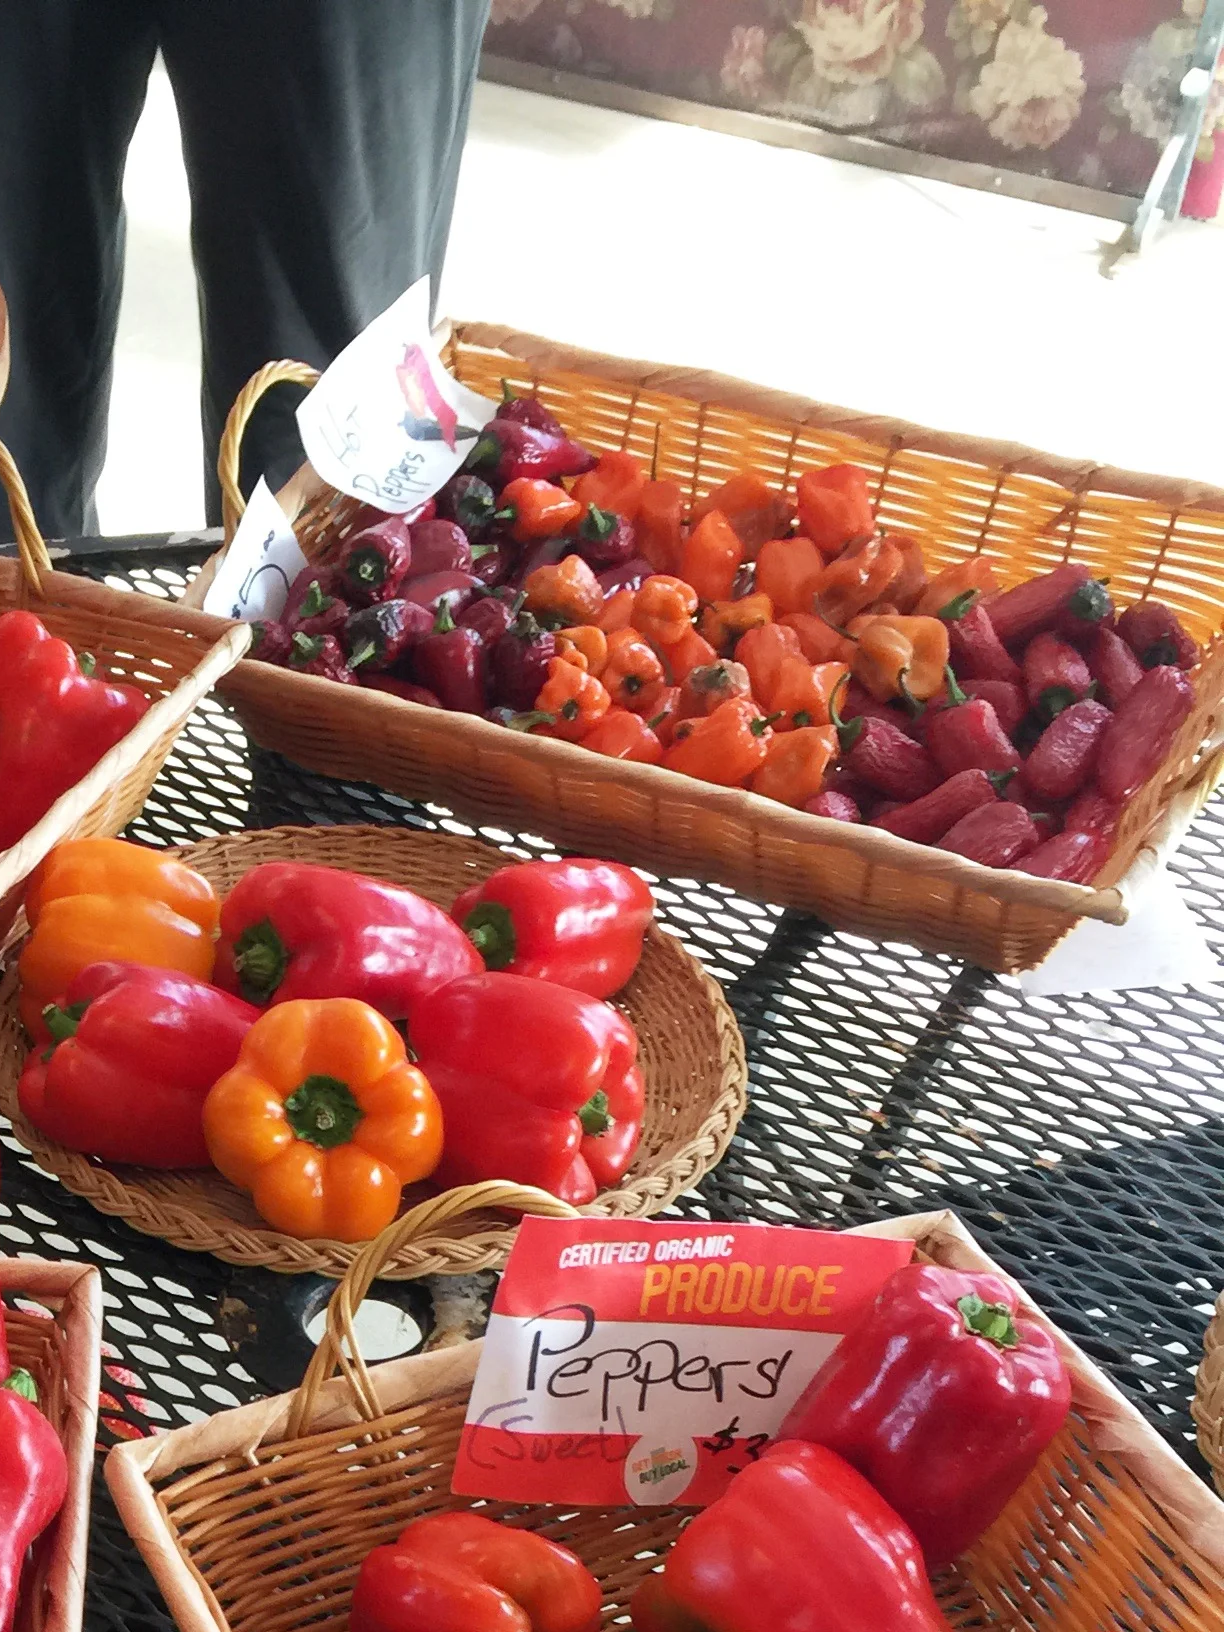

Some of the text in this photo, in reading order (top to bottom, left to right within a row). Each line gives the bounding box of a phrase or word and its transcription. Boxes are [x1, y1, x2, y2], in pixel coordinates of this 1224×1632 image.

[559, 1234, 735, 1269] CERTIFIED ORGANIC
[640, 1261, 844, 1316] PRODUCE
[522, 1303, 793, 1421] Peppers
